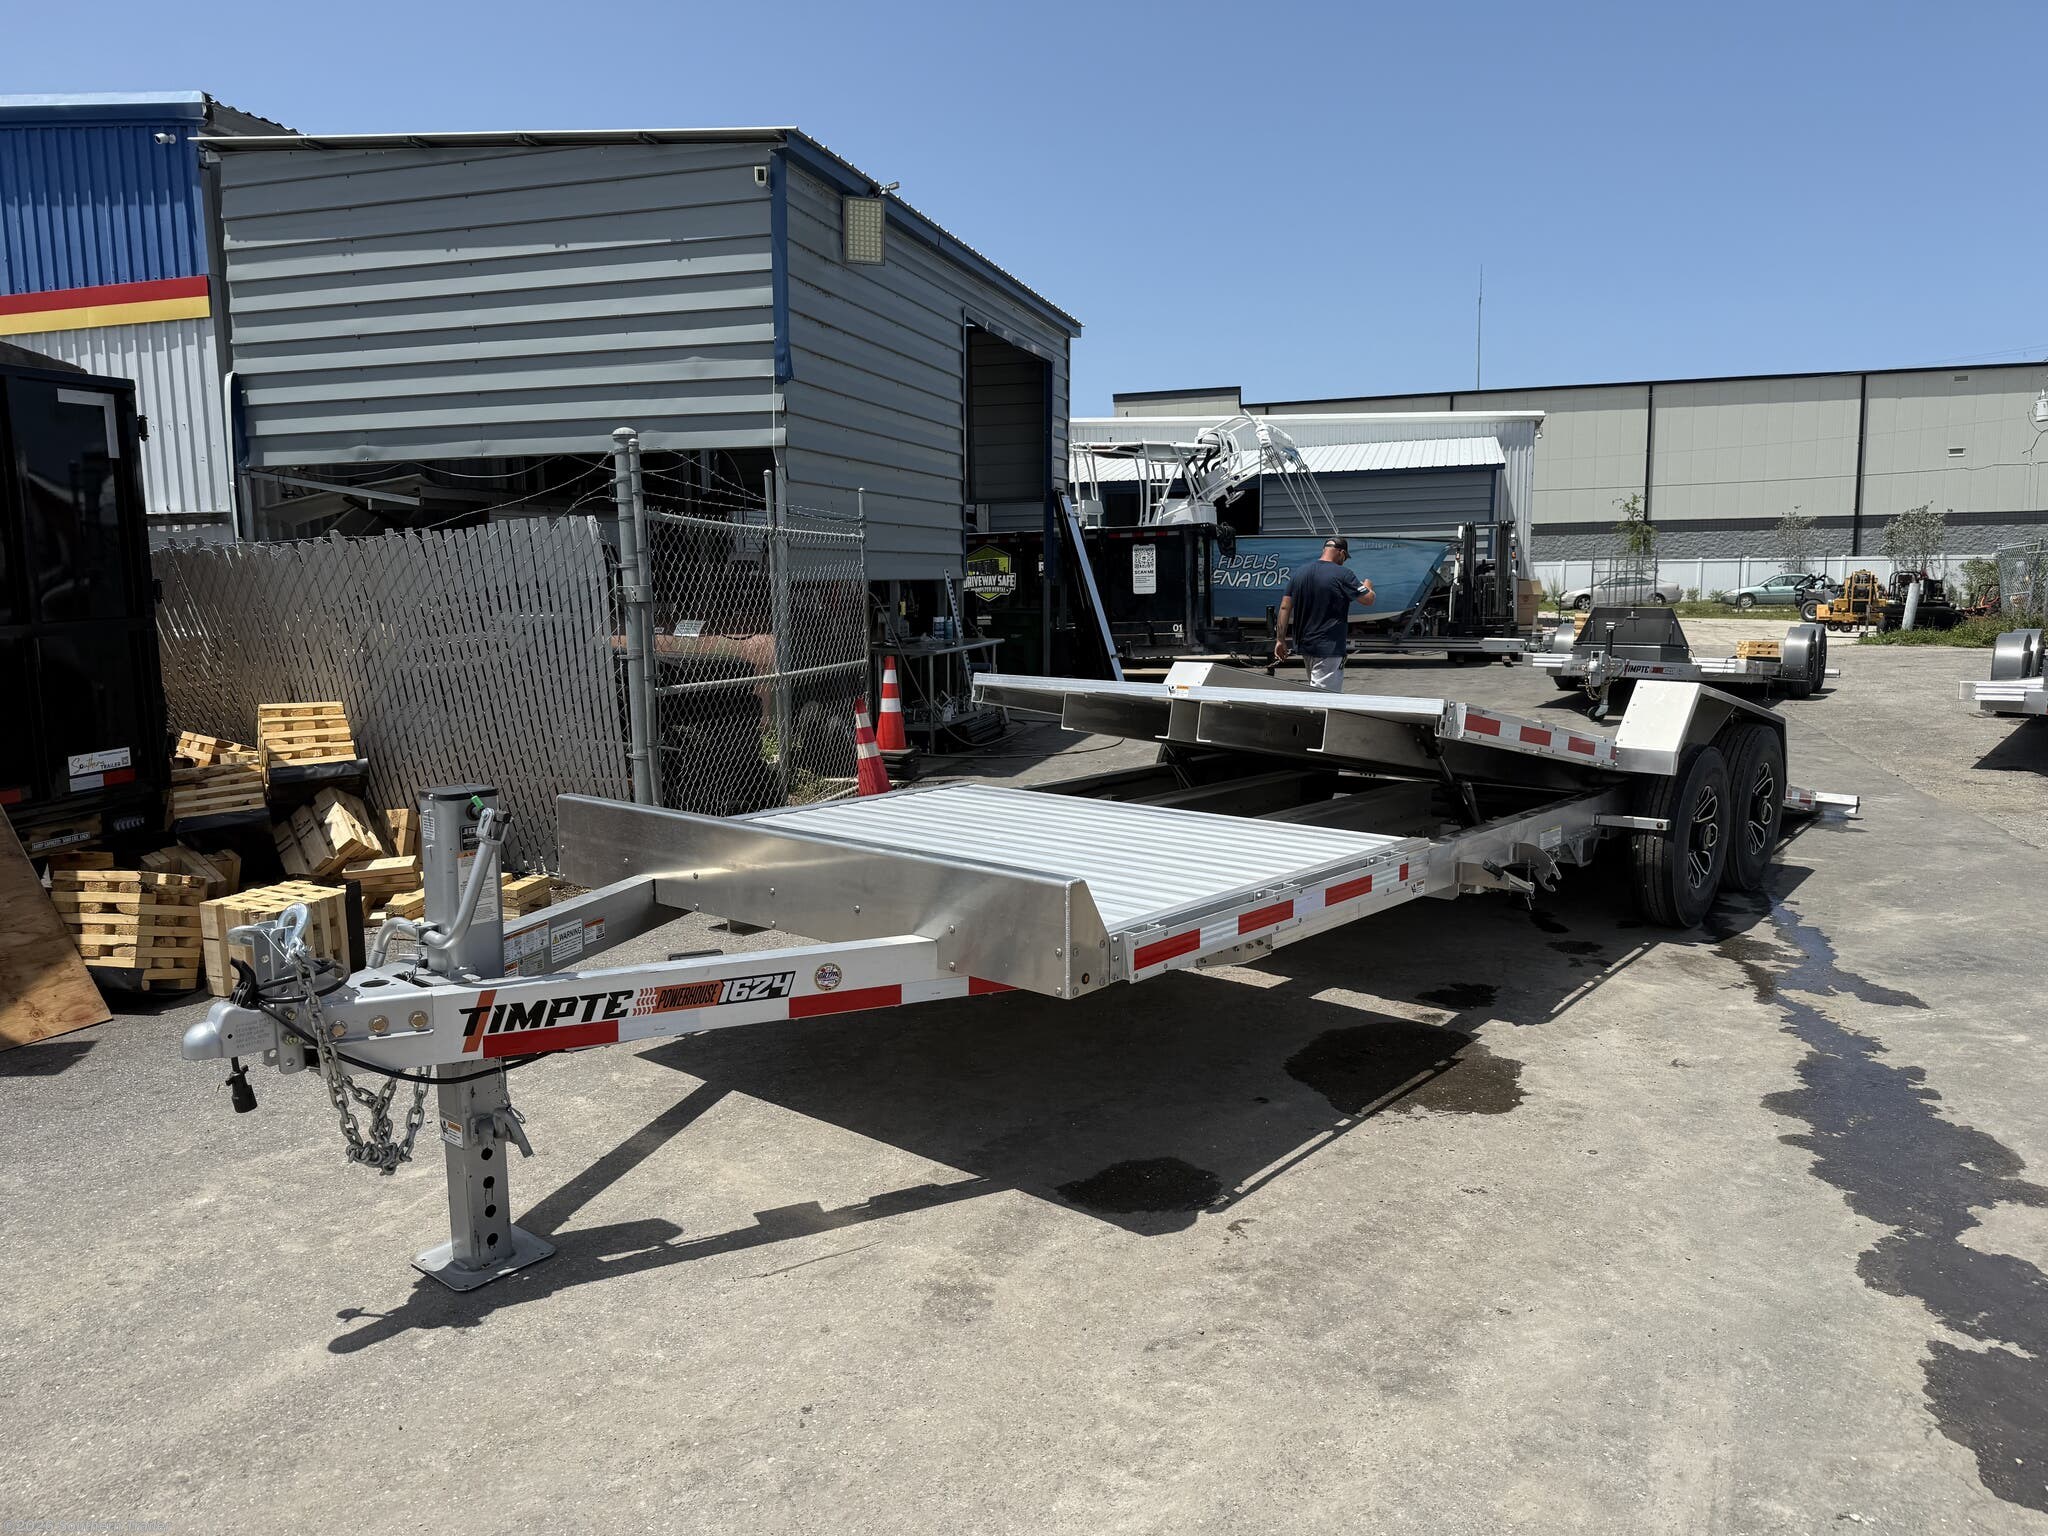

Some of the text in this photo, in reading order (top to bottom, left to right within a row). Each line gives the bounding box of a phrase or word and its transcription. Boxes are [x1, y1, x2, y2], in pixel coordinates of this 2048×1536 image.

[1218, 553, 1280, 569] FIDELIS
[963, 574, 1015, 588] DRIVEWAY SAFE
[1211, 567, 1291, 588] ENATOR
[1172, 623, 1183, 633] 01
[1623, 663, 1650, 674] TIMPTE
[559, 926, 582, 942] WARNING
[459, 989, 635, 1046] TIMPTE
[656, 982, 720, 1010] POWERHOUSE
[719, 973, 795, 1004] 1624
